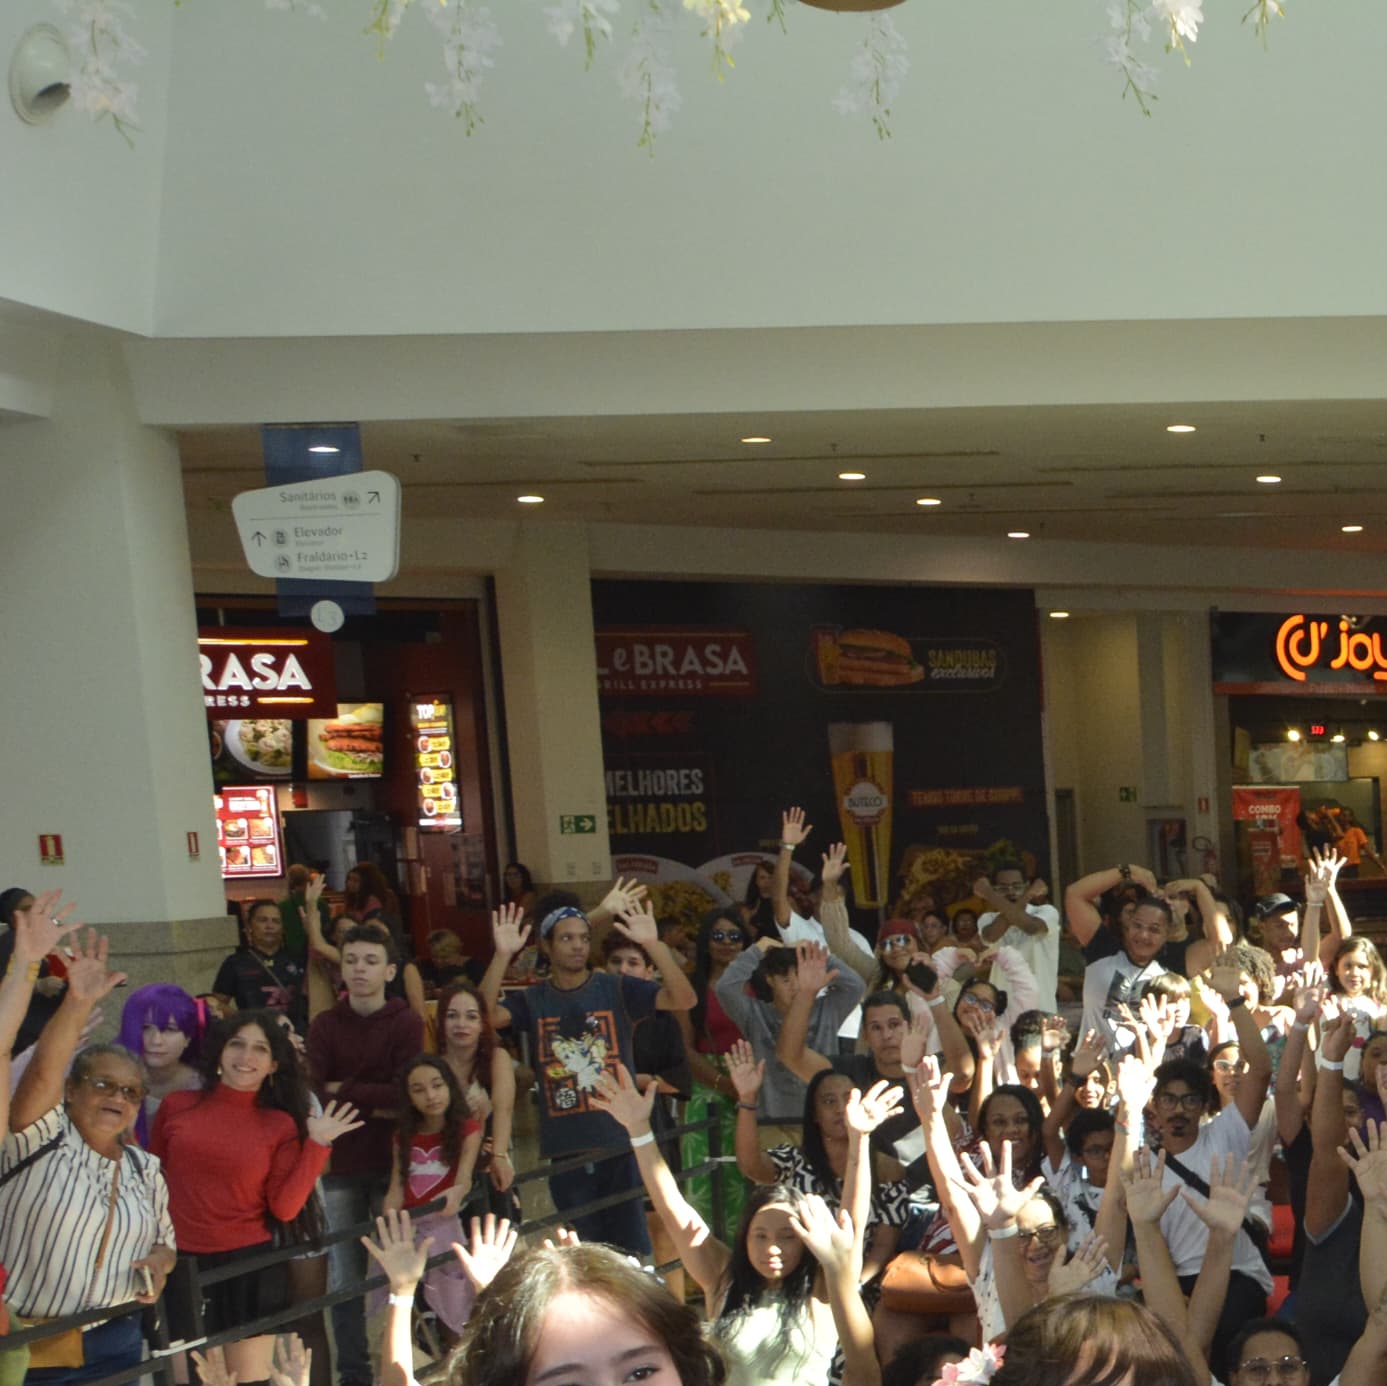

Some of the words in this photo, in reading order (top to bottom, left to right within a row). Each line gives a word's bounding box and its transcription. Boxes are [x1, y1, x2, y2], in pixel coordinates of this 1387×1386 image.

[279, 489, 336, 503] Sanitários
[294, 526, 342, 538] Elevador
[640, 679, 703, 689] EXPRESS
